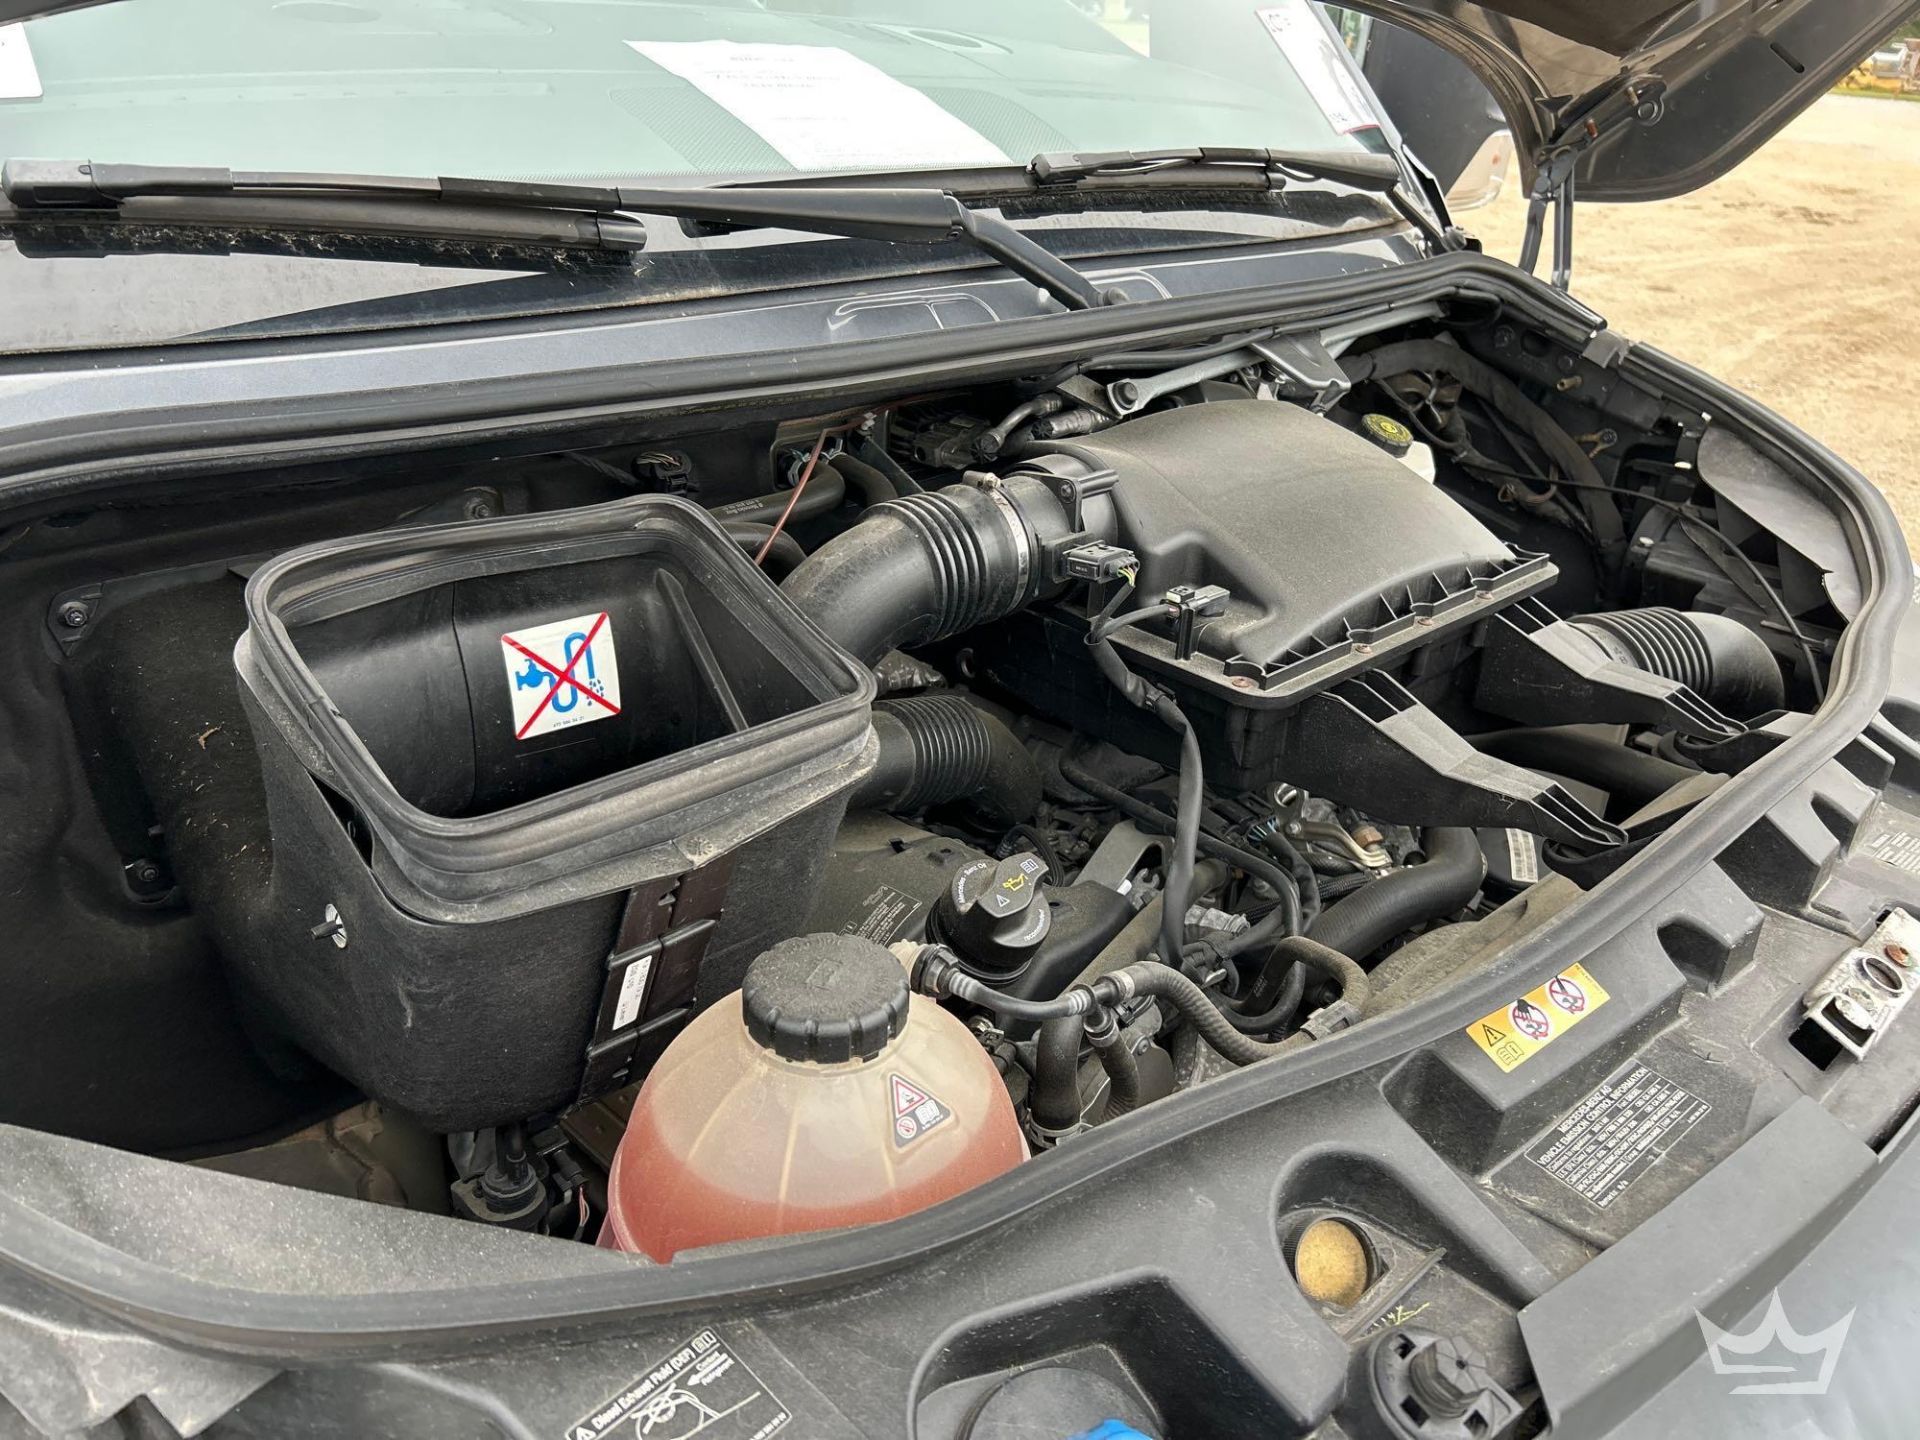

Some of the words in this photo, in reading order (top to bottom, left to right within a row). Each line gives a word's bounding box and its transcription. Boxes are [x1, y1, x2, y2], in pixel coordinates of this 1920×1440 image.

[1537, 1141, 1565, 1165] VEHICLE
[1560, 1119, 1591, 1145] EMISSION
[1585, 1098, 1615, 1121] CONTROL
[1609, 1066, 1649, 1100] INFORMATION
[1557, 1092, 1605, 1133] MERCEDES-BENZ
[1599, 1085, 1612, 1096] AG
[591, 1402, 623, 1430] Diesel
[617, 1379, 655, 1409] Exhaust
[649, 1362, 675, 1385] Fluid
[669, 1347, 696, 1371] (DEF)
